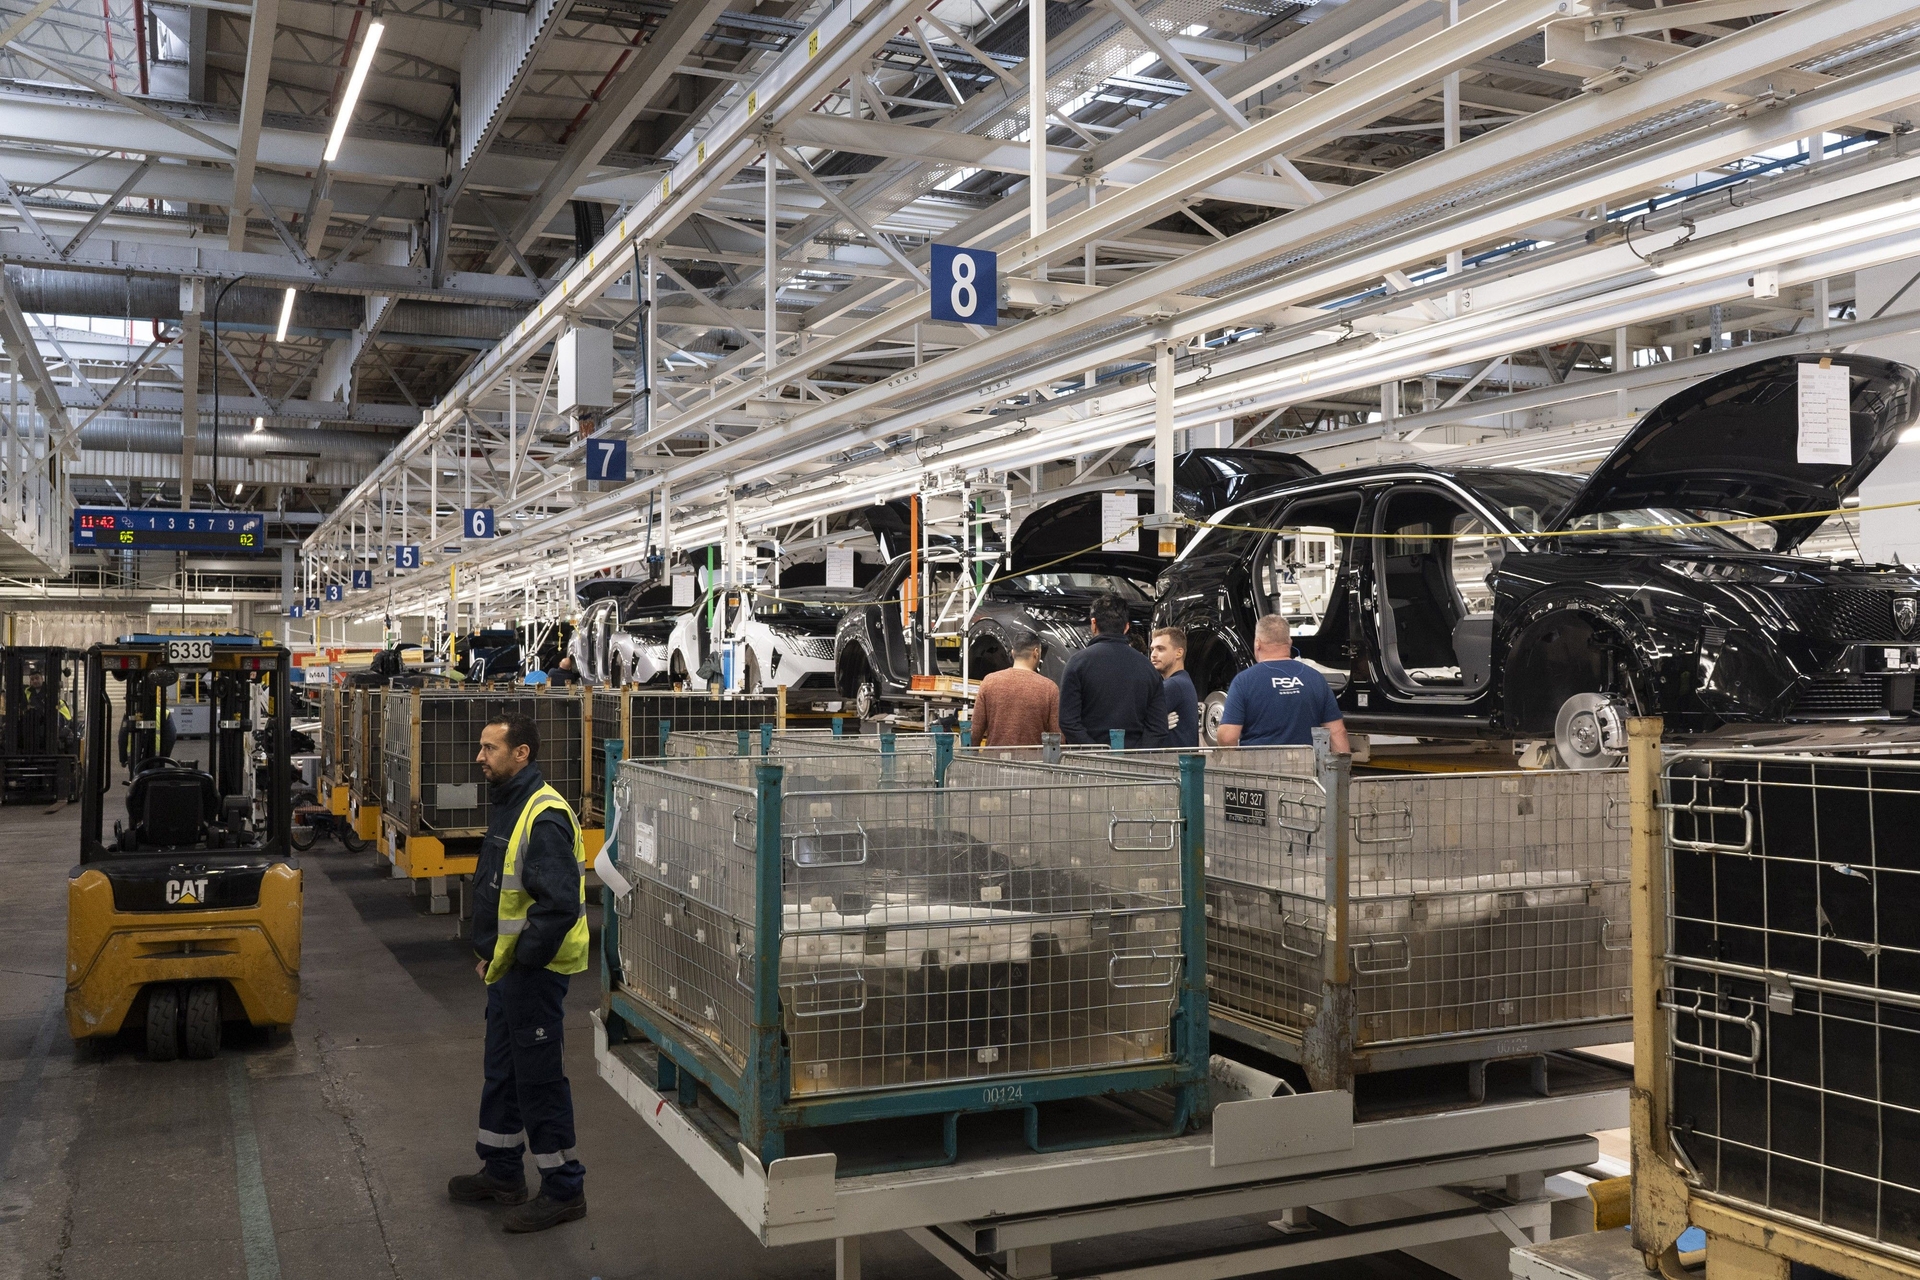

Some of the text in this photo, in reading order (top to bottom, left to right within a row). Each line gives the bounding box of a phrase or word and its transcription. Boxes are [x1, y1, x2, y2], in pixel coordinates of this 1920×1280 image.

[951, 253, 977, 317] 8
[598, 442, 615, 477] 7
[80, 515, 116, 528] 11:42
[149, 517, 235, 531] 1 3 5 7 9
[472, 511, 486, 536] 6
[119, 531, 254, 546] 05 02
[402, 547, 412, 567] 5
[358, 571, 367, 587] 4
[331, 588, 338, 600] 3
[294, 606, 299, 617] 1
[309, 599, 316, 610] 2
[169, 642, 212, 659] 6330
[1271, 676, 1305, 689] PSA
[1226, 791, 1263, 806] PCA 67 327
[165, 879, 208, 904] CAT
[982, 1085, 1023, 1104] 00124
